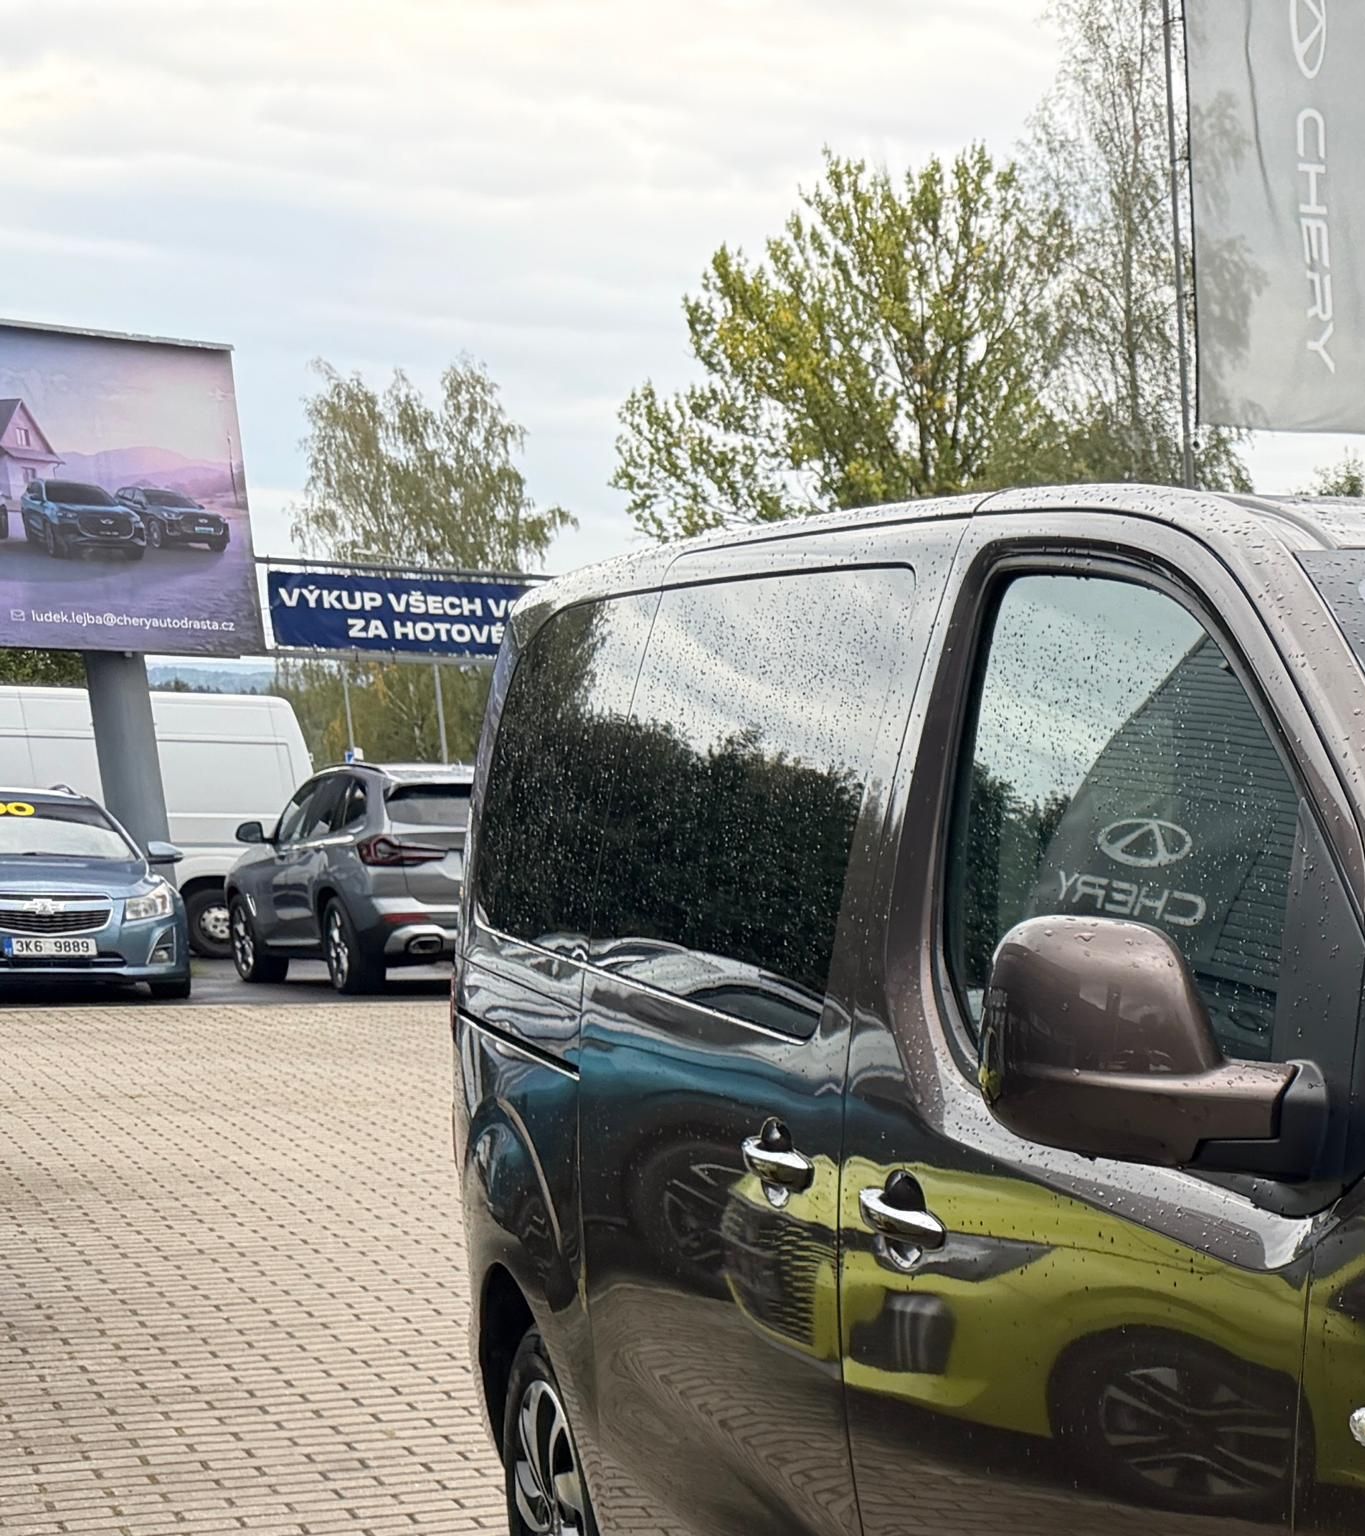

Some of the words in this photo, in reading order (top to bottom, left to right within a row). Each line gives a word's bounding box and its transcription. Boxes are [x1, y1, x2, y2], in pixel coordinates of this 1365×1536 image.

[1296, 107, 1335, 374] CHERY
[278, 584, 383, 611] VÝKUP
[387, 590, 483, 616] VŠECH
[31, 609, 236, 631] ludek.lejba@cheryautodrasta.cz
[347, 618, 388, 639] ZA
[15, 940, 44, 953] 3K6
[53, 941, 90, 954] 9889
